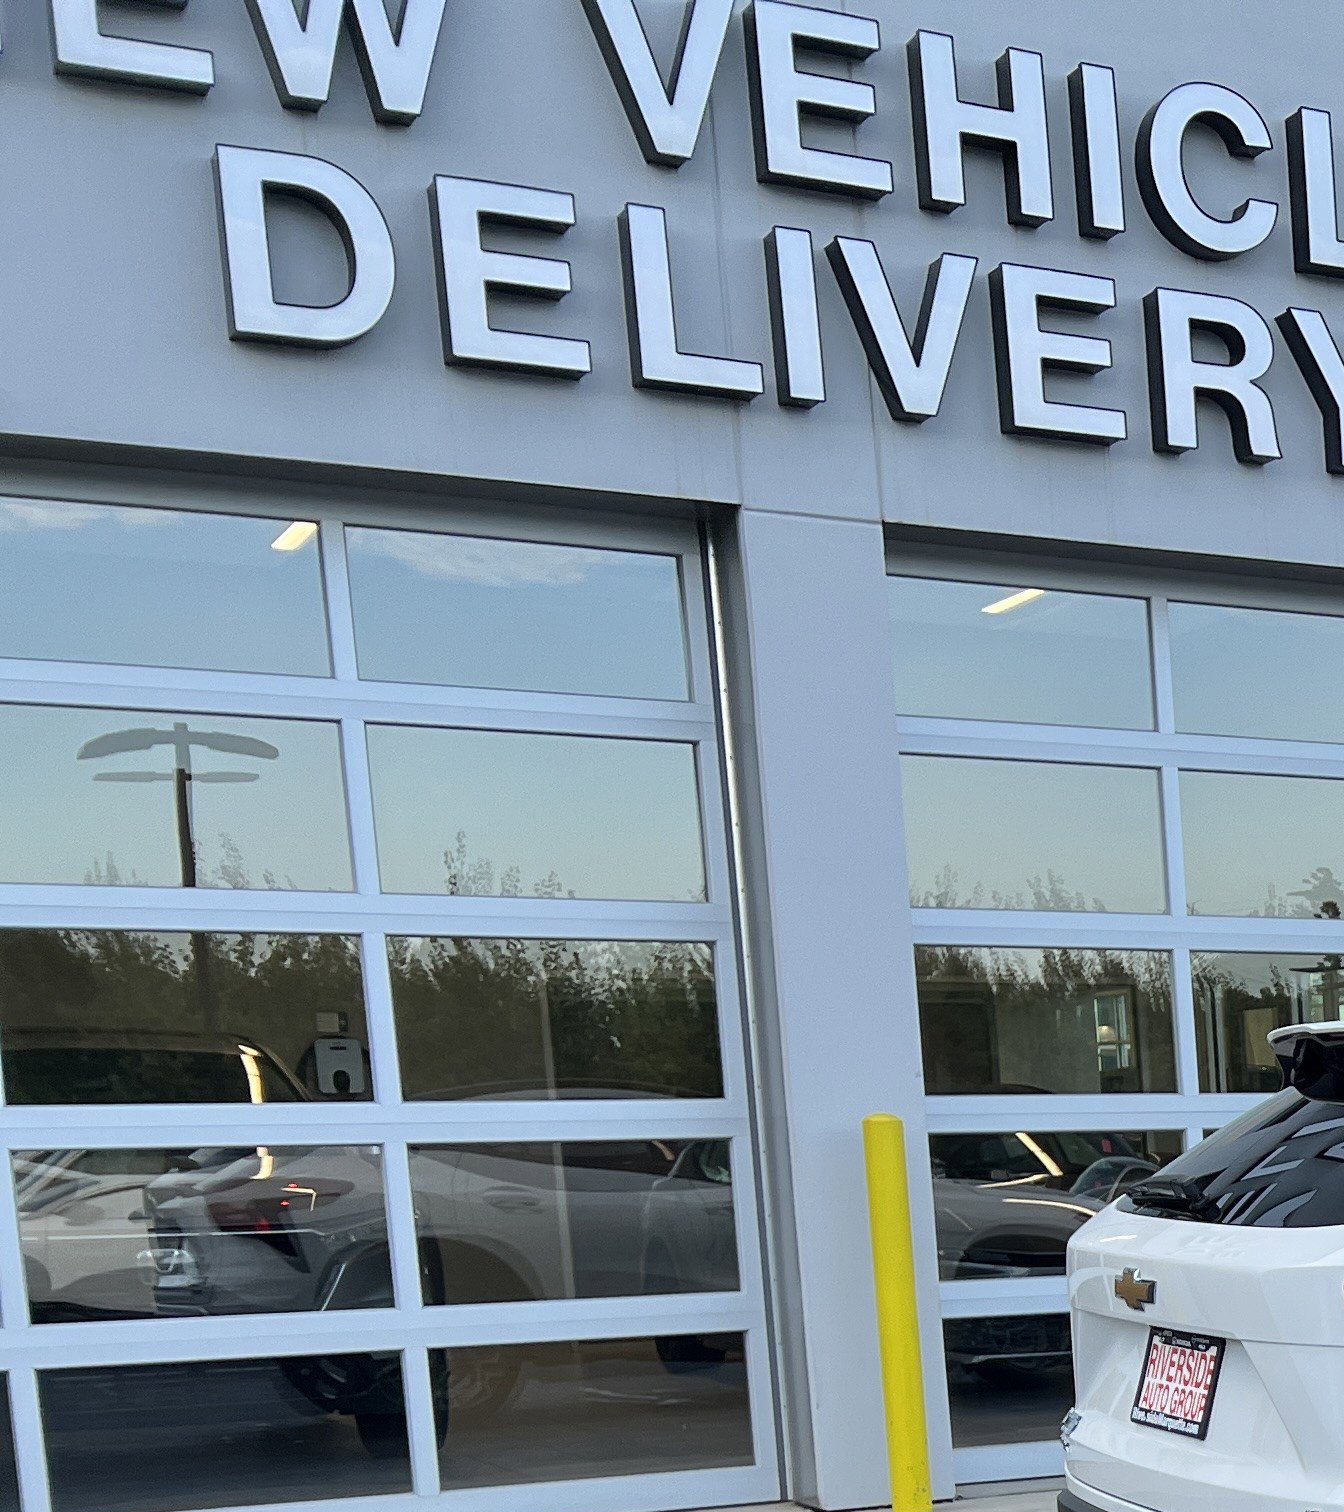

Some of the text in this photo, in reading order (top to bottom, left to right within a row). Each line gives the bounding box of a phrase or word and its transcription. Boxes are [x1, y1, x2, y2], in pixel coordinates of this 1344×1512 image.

[1146, 1343, 1217, 1391] RIVERSIDE
[1141, 1380, 1170, 1412] AUTO
[1169, 1386, 1208, 1420] GROUP
